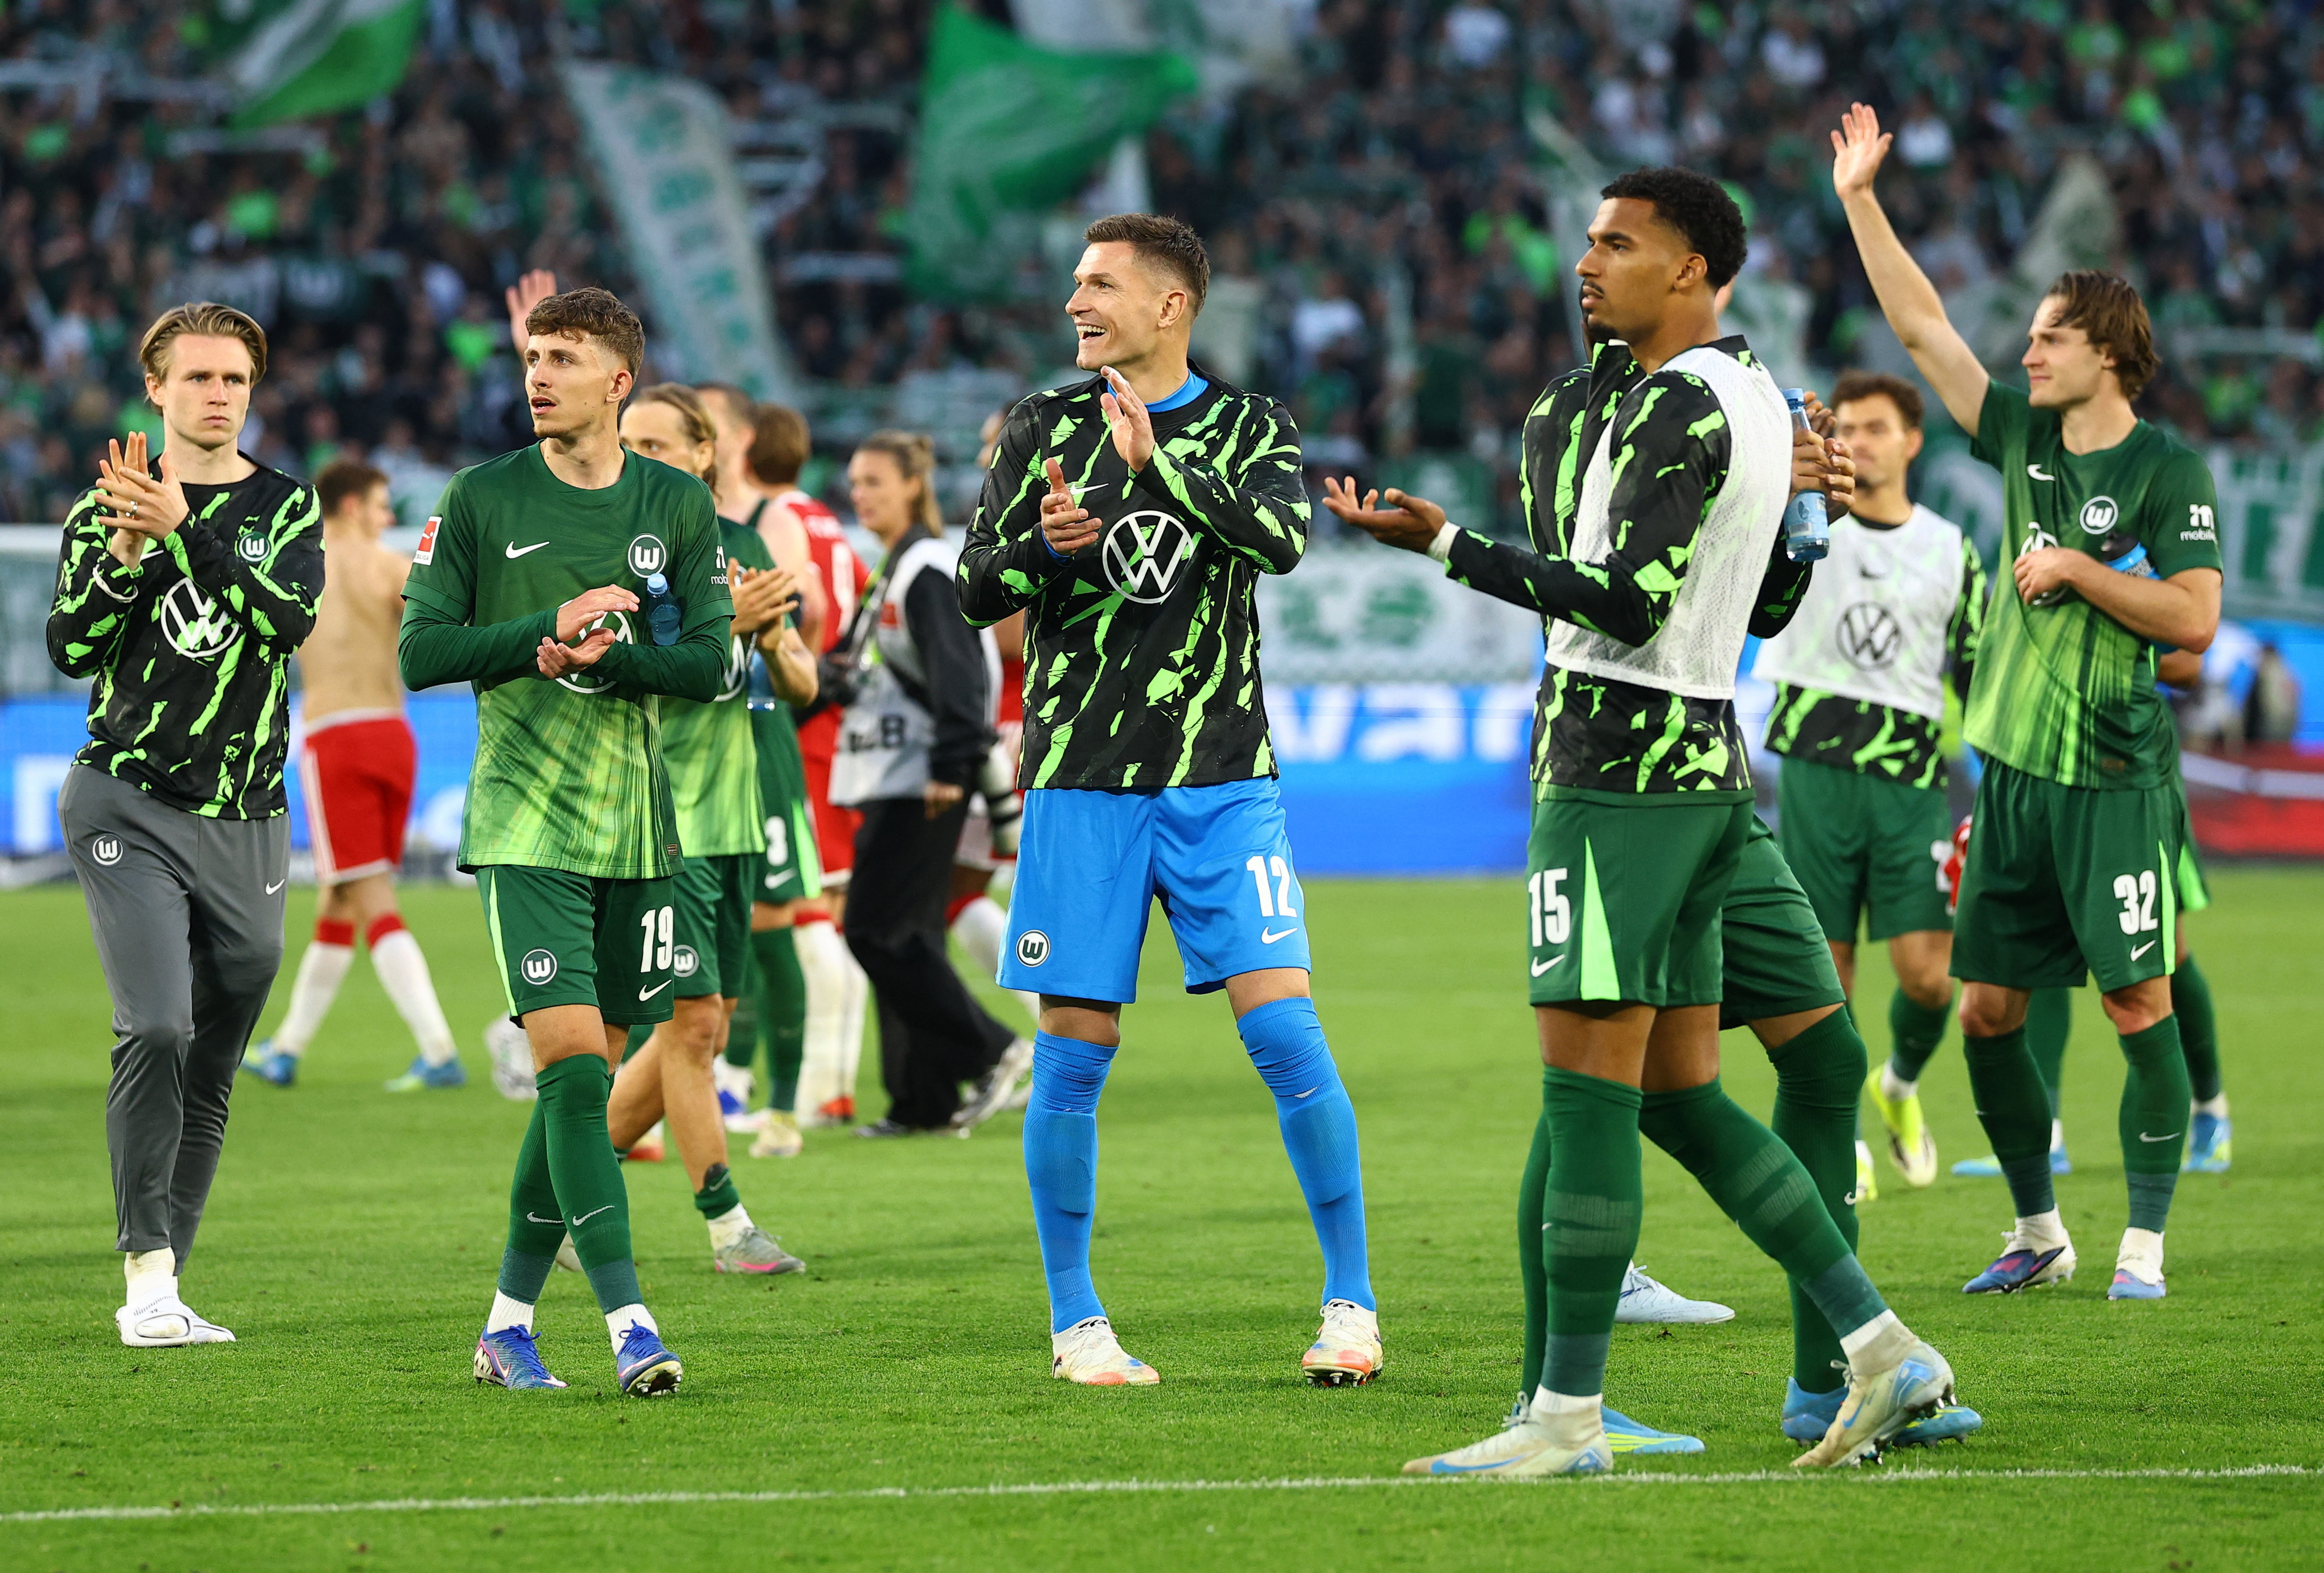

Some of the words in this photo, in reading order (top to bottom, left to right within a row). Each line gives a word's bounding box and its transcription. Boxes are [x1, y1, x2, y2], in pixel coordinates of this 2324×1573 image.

[634, 545, 660, 570] W
[1246, 855, 1297, 917] 12
[1527, 867, 1571, 947] 15
[2113, 870, 2158, 935] 32
[527, 957, 551, 979] W
[640, 905, 674, 974] 19
[1022, 939, 1044, 960] W
